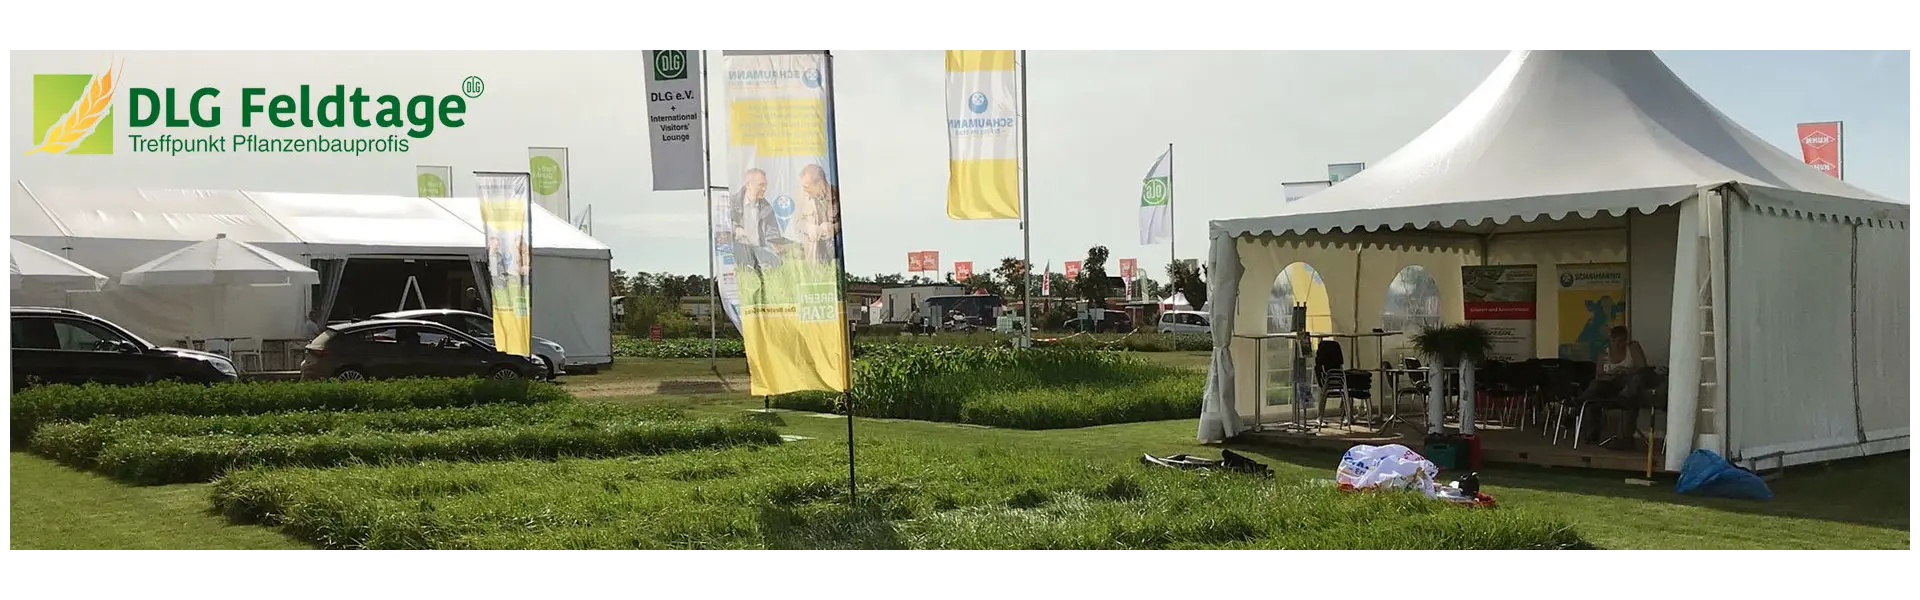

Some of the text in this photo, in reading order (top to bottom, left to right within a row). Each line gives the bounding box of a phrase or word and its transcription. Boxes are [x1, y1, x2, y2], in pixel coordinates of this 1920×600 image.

[661, 52, 680, 72] DLG
[651, 90, 695, 102] DLG e.V.
[650, 113, 698, 123] International
[660, 123, 690, 132] Visitors'
[662, 133, 690, 142] Lounge
